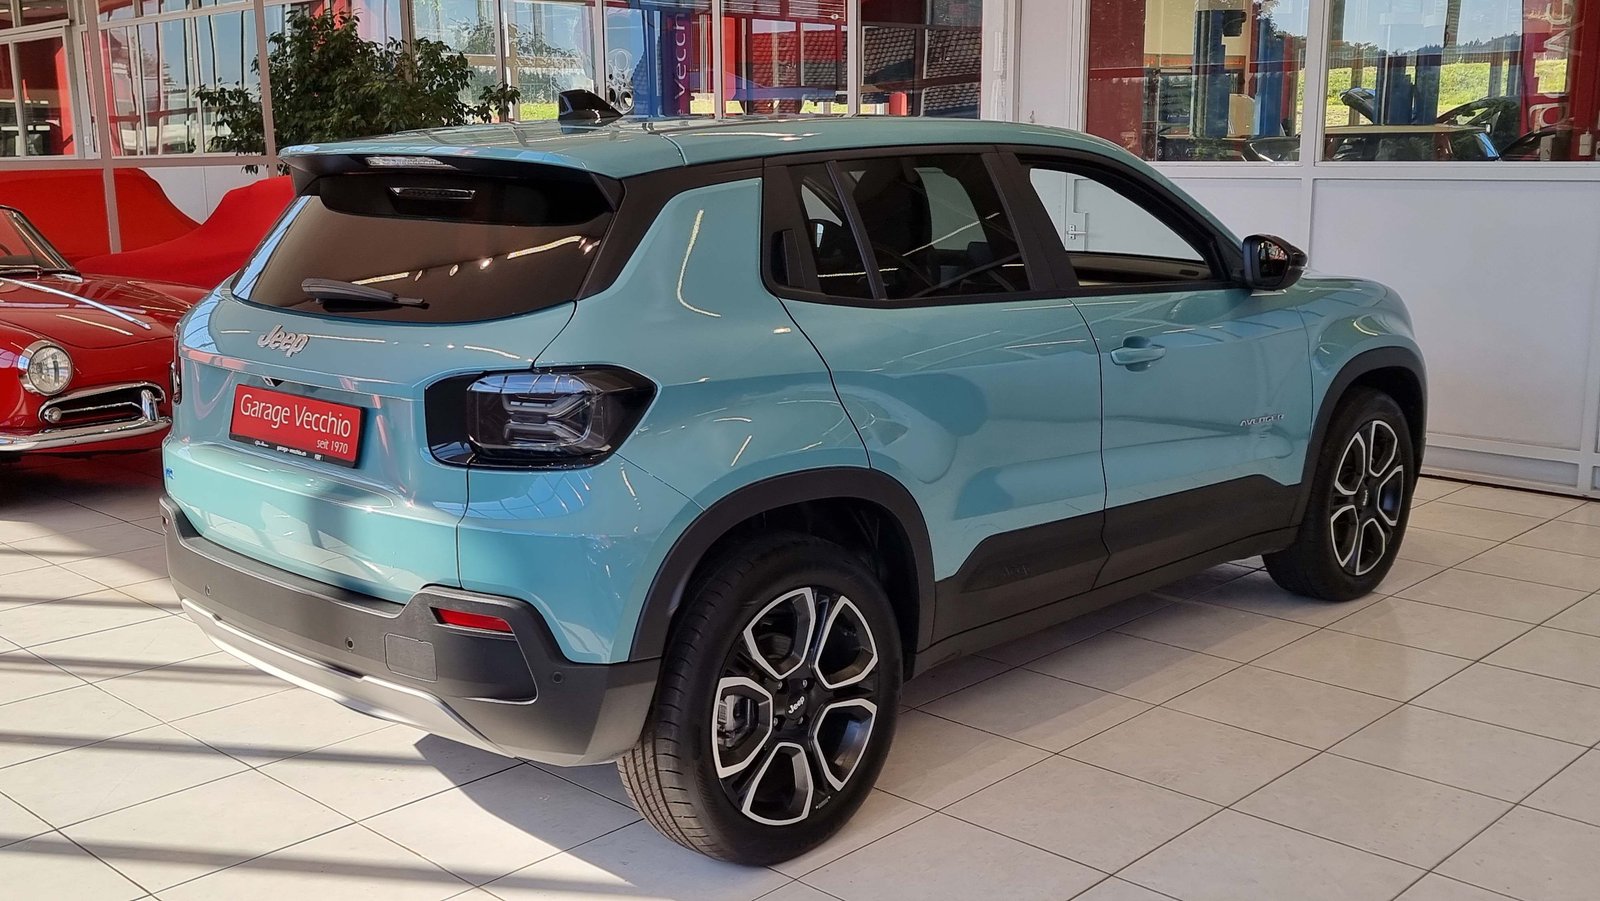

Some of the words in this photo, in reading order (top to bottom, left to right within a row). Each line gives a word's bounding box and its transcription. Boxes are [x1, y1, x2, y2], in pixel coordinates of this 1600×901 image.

[257, 324, 309, 358] Jeep
[240, 394, 290, 429] Garage
[294, 404, 351, 437] Vecchio
[316, 439, 329, 450] seit
[330, 440, 349, 455] 1970
[788, 696, 805, 714] Jeep
